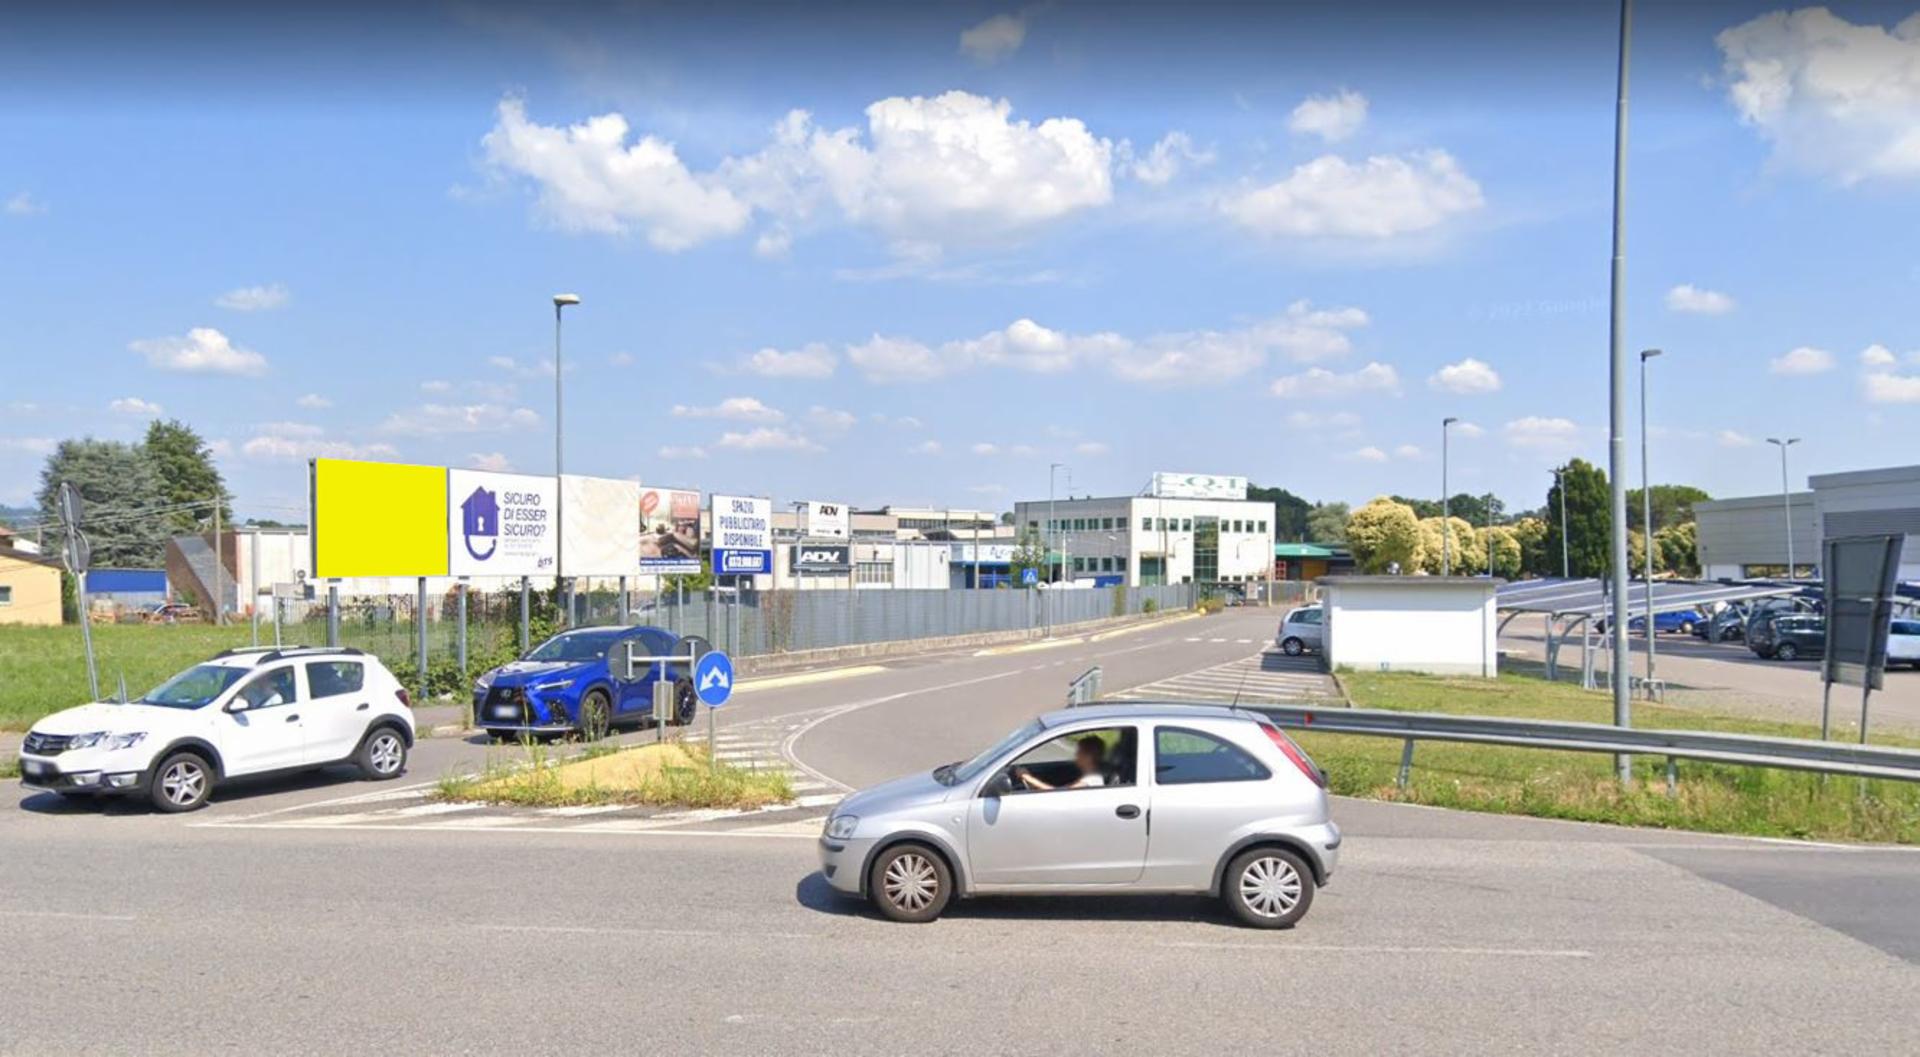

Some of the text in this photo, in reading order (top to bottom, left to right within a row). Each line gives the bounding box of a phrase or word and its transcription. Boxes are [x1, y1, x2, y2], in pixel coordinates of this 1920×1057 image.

[503, 491, 541, 506] SICURO
[731, 499, 754, 514] SPAZIO
[503, 508, 547, 521] DI ESSER
[503, 523, 547, 537] SICURO?
